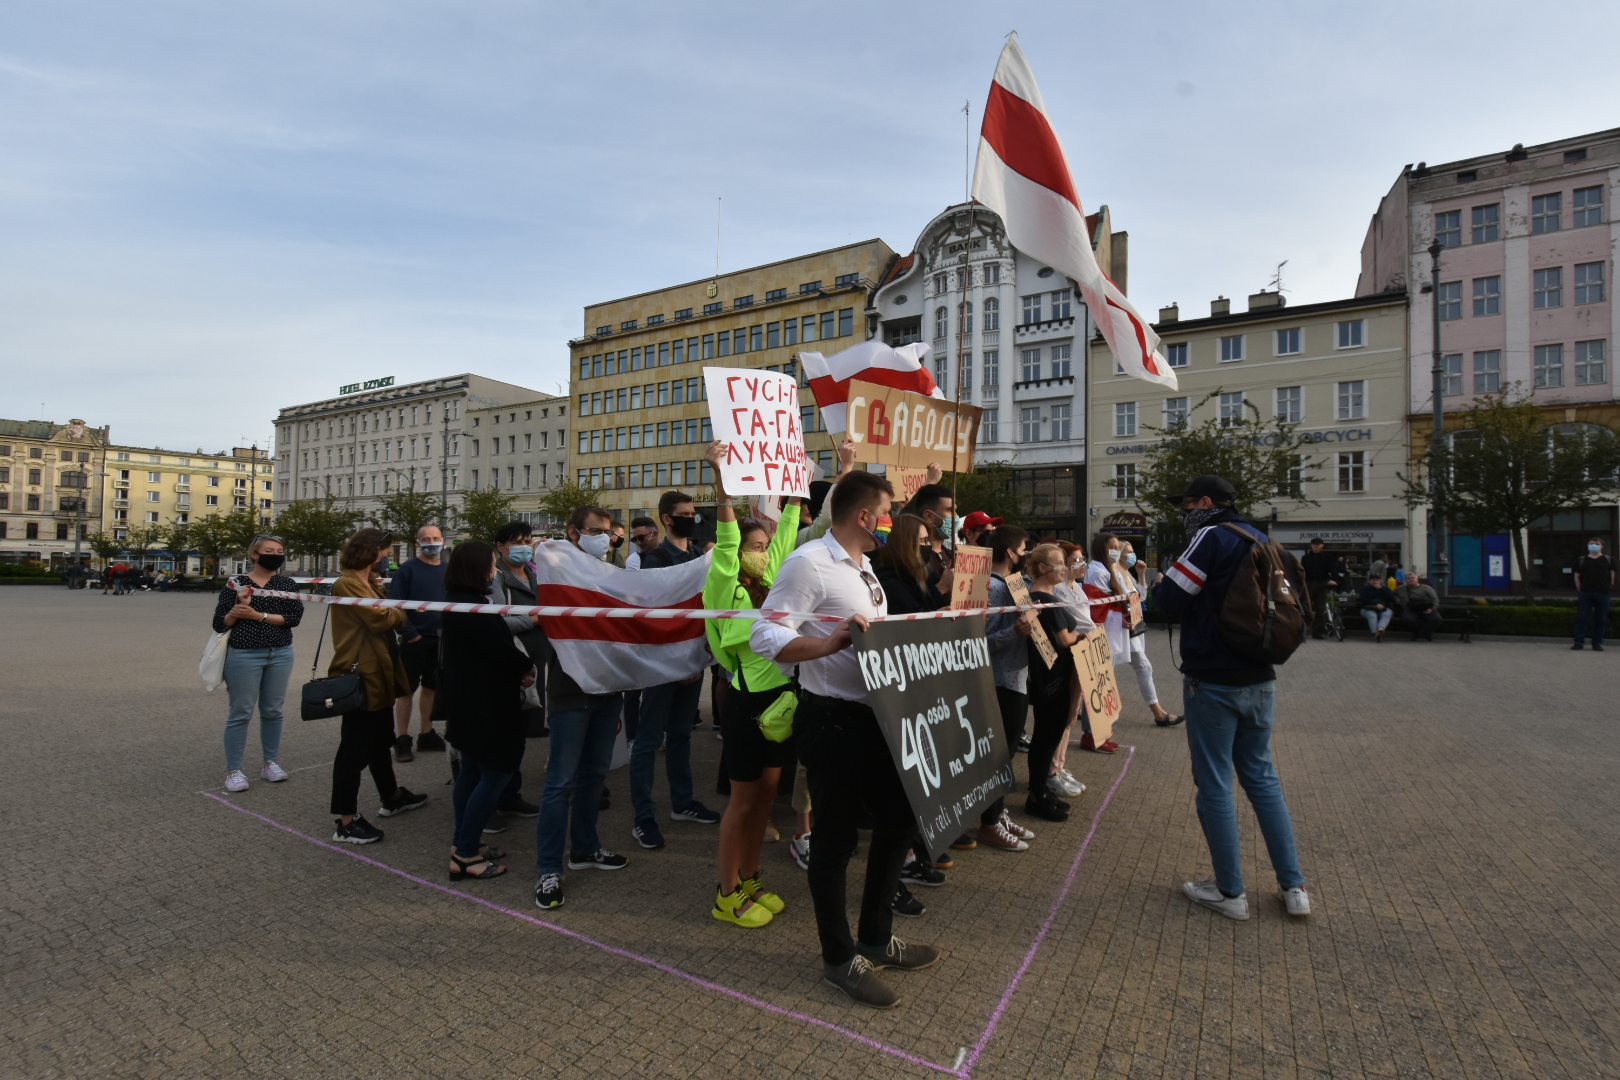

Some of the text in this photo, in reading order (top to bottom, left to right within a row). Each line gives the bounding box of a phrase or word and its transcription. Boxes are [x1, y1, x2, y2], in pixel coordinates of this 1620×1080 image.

[949, 240, 981, 253] BANK
[339, 376, 395, 395] HOTEL RZYMSKI
[849, 396, 973, 453] СВАБОДУ
[1300, 428, 1372, 444] OBCYCH
[1300, 532, 1330, 540] JUBILER
[858, 644, 907, 692] KRAJ
[902, 637, 991, 681] PROSPOŁECZNY
[927, 696, 951, 725] osób
[954, 695, 976, 765] 5
[901, 712, 941, 798] 40
[948, 758, 964, 777] na
[935, 806, 952, 834] celi
[952, 800, 963, 827] po
